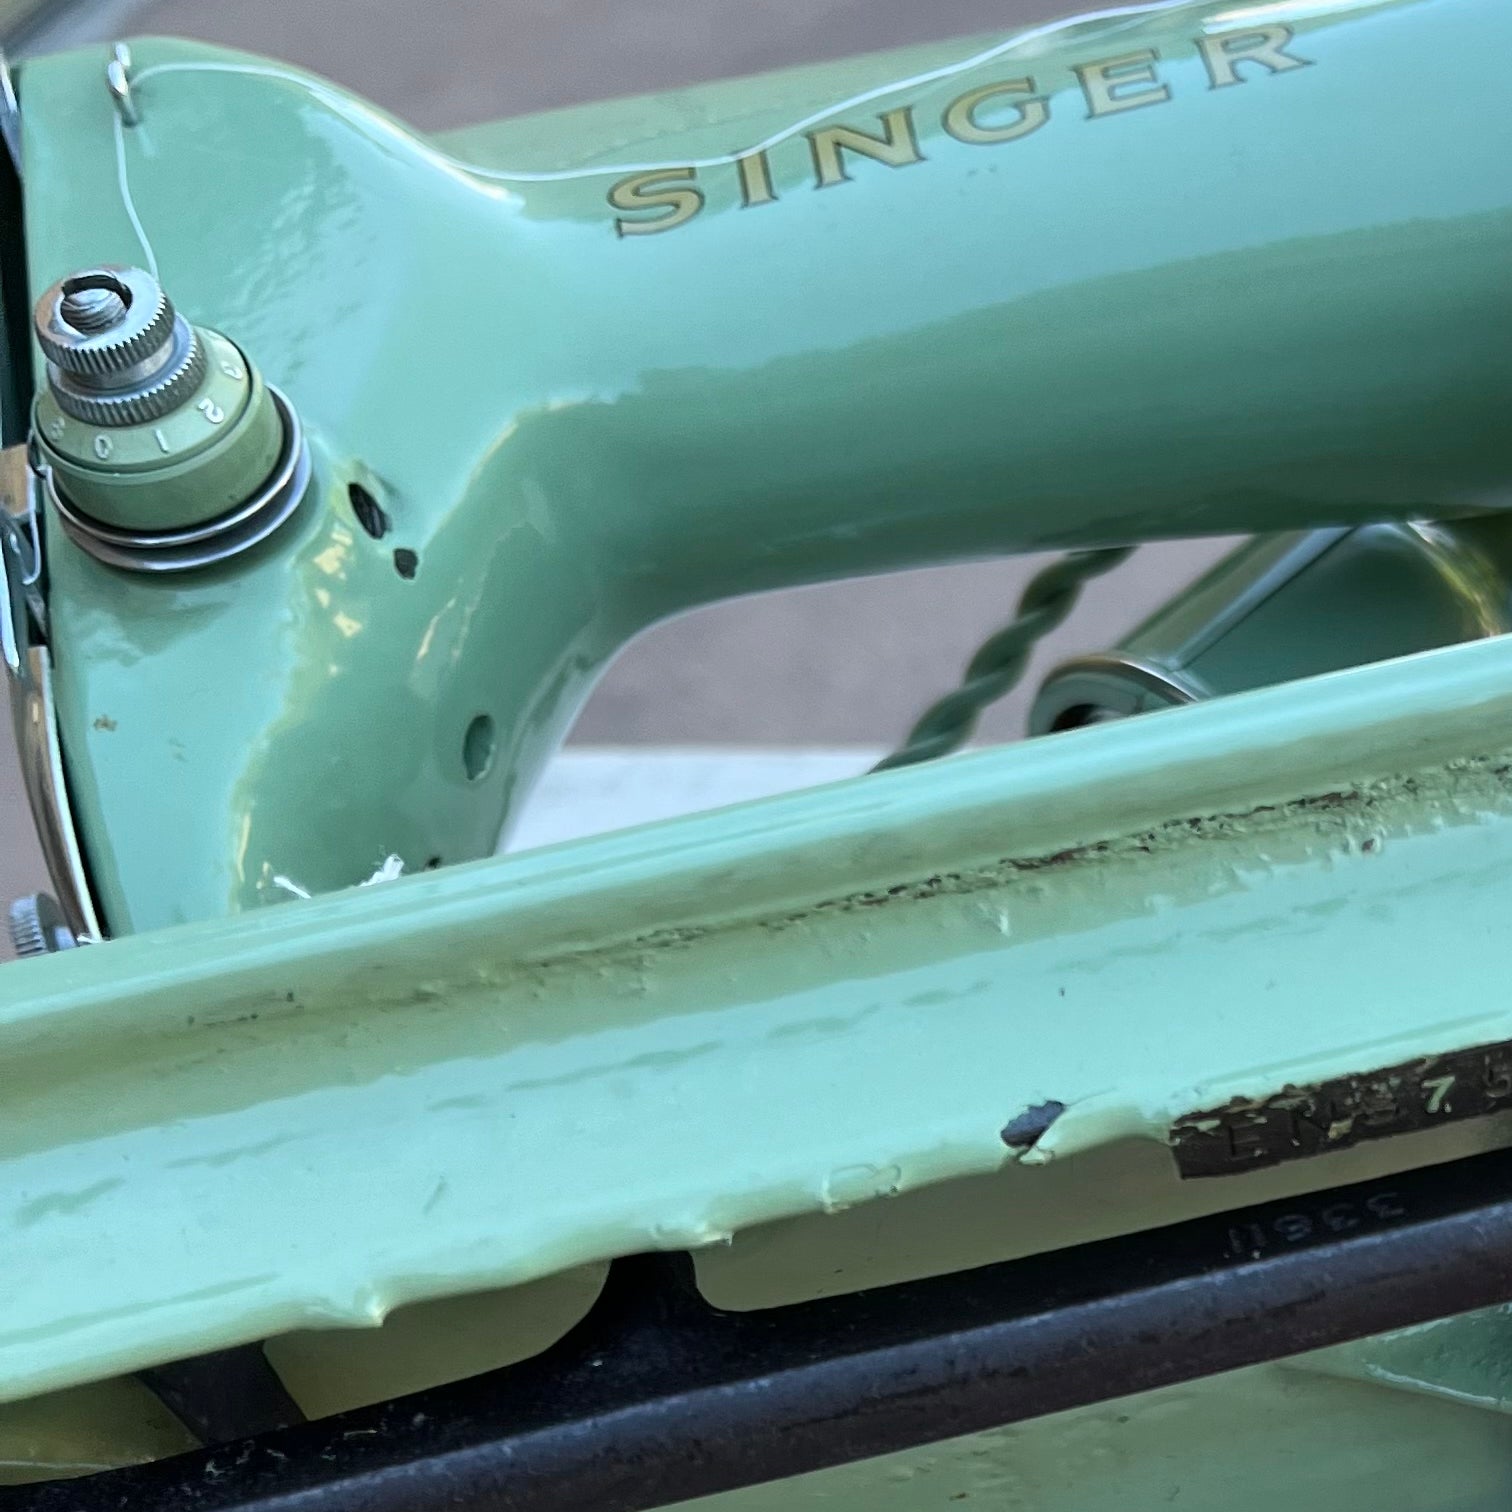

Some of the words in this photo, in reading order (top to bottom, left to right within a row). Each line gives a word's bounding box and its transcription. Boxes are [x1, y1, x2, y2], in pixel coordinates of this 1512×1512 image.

[606, 22, 1316, 239] SINGER
[94, 434, 113, 459] 0
[199, 398, 224, 424] 2
